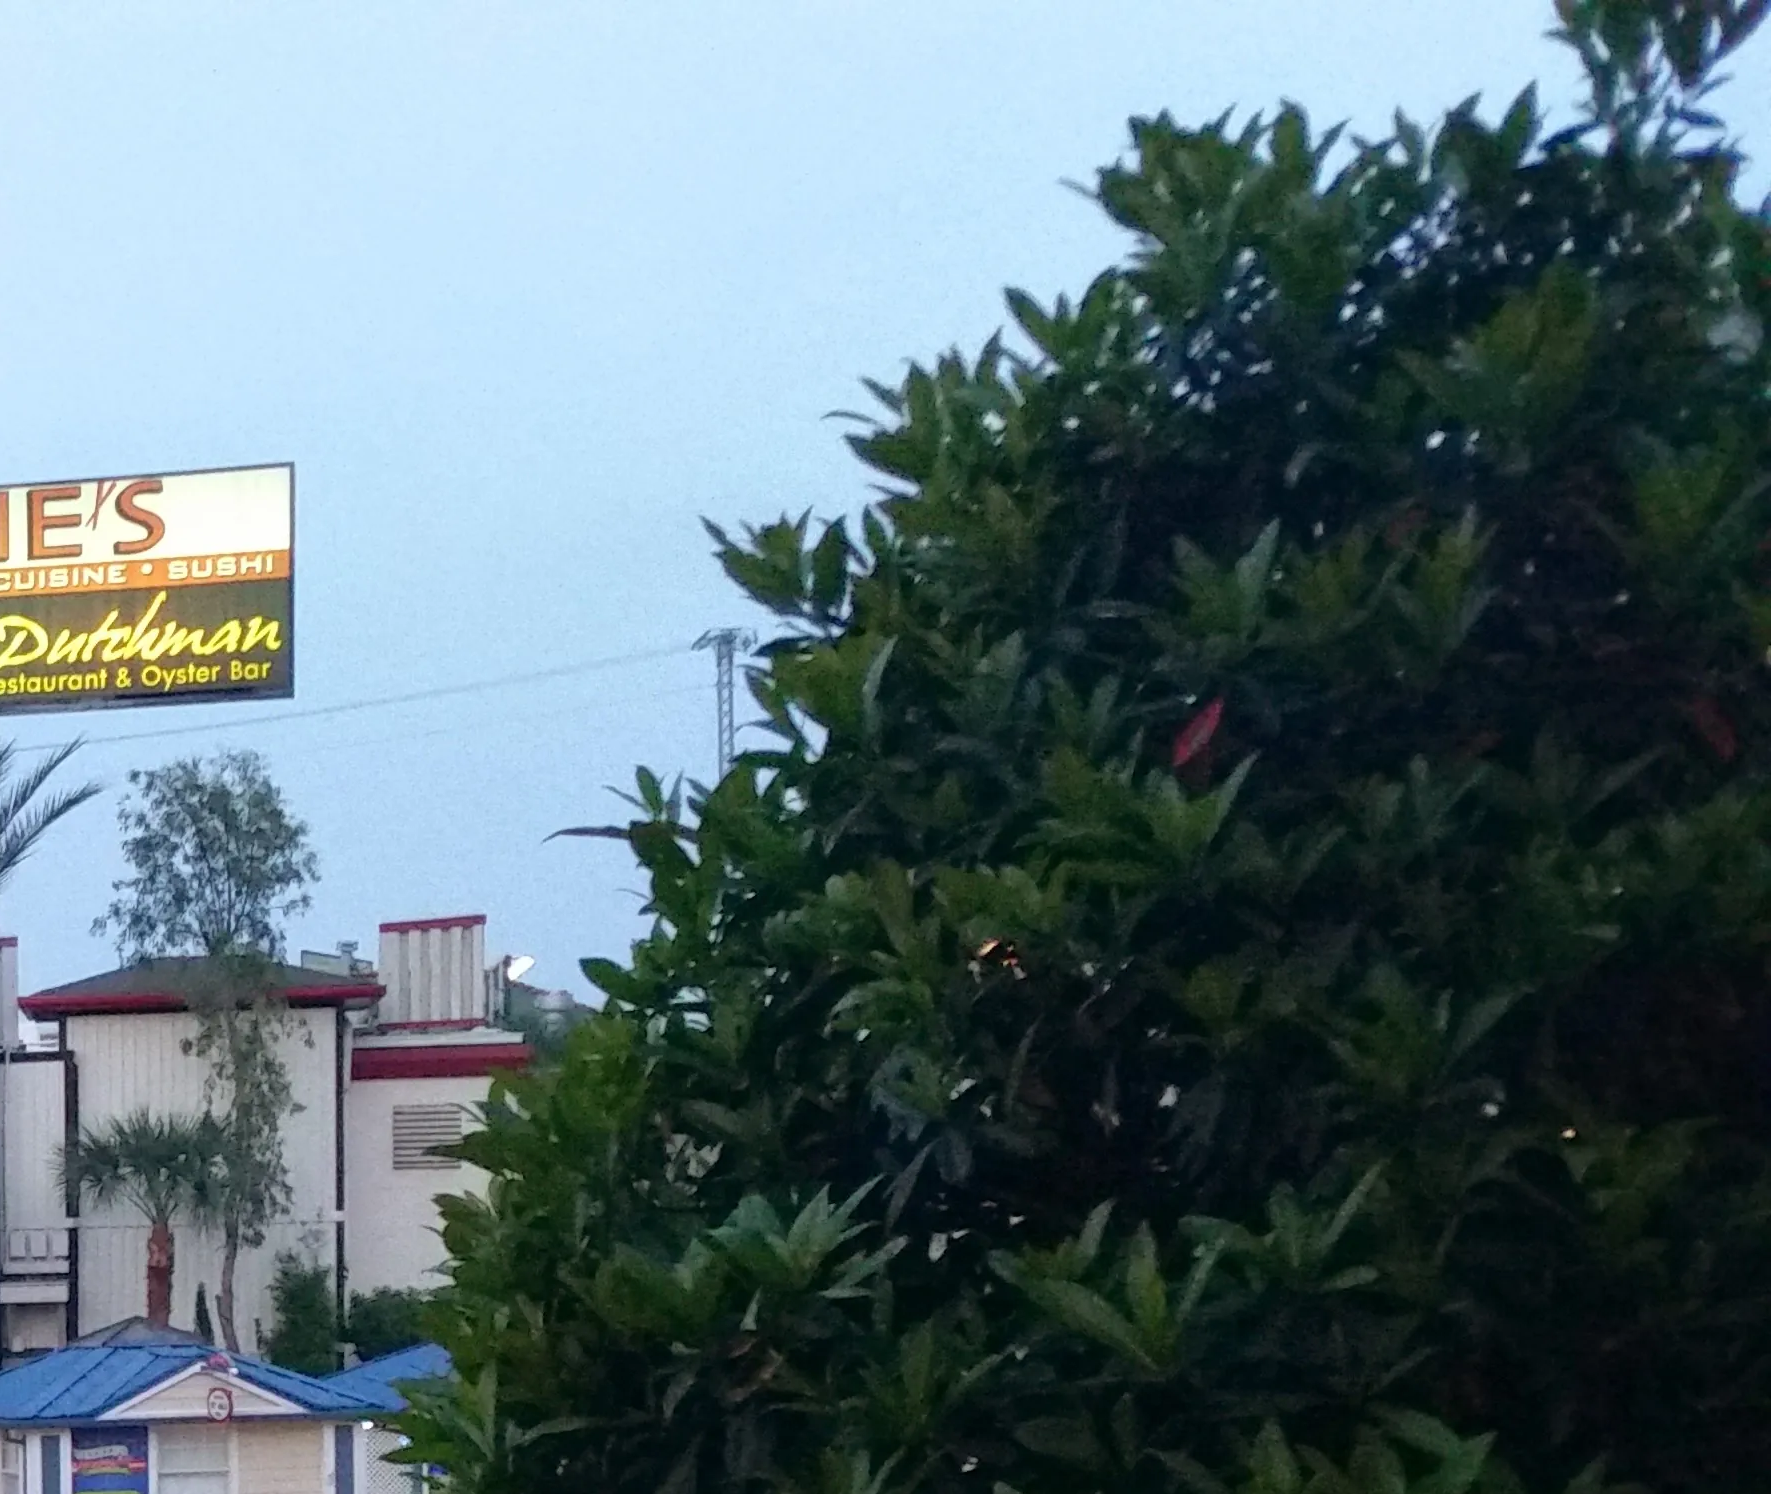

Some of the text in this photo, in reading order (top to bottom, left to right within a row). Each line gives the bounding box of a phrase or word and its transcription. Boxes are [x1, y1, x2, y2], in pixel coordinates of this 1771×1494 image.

[167, 553, 274, 580] SUSHI
[115, 667, 132, 689] &
[141, 662, 221, 691] Oyster
[230, 660, 272, 681] Bar
